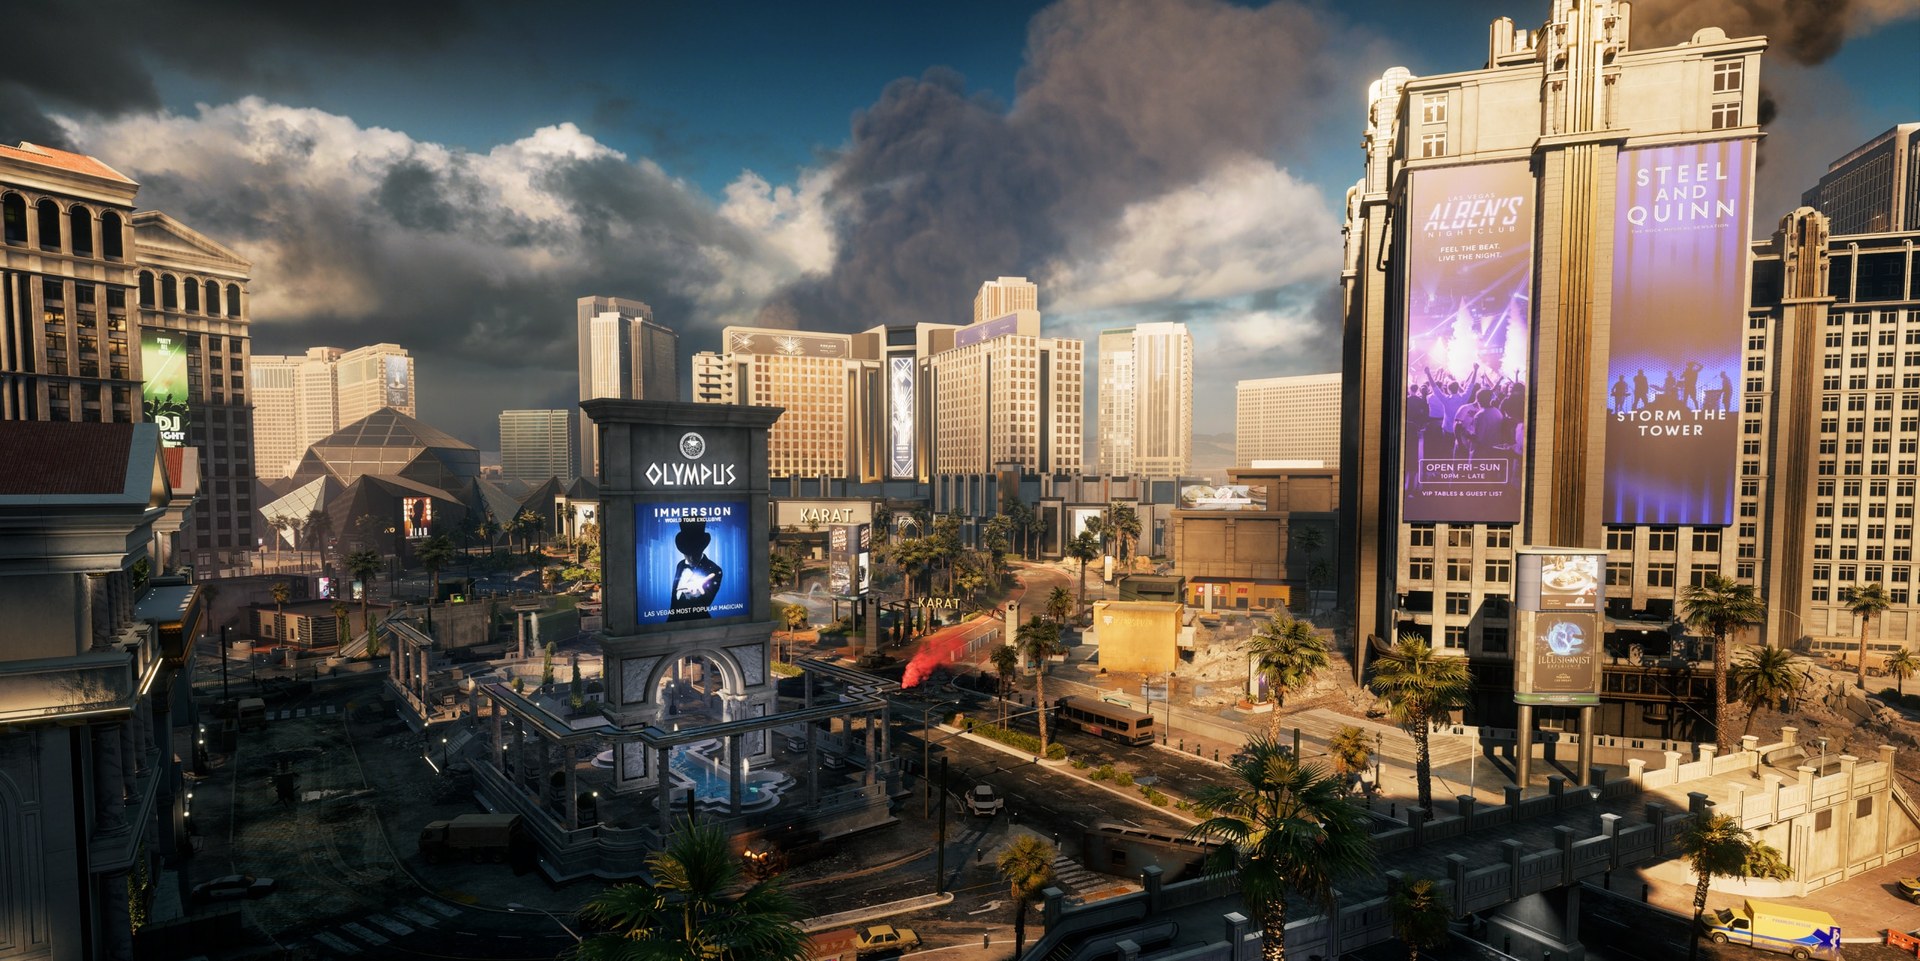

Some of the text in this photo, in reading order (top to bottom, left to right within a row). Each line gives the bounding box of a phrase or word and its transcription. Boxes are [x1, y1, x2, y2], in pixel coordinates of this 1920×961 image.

[1636, 161, 1728, 187] STEEL
[1655, 185, 1707, 202] AND
[1423, 196, 1524, 231] ALBEN'S
[1627, 199, 1735, 226] QUINN
[1427, 226, 1515, 238] NIGHTCLUB
[1479, 243, 1501, 251] BEAT.
[1458, 253, 1473, 261] THE
[1475, 252, 1503, 260] NIGHT.
[1617, 408, 1726, 422] STORM THE
[154, 414, 180, 431] DJ
[160, 431, 185, 440] IGHT
[1638, 424, 1703, 437] TOWER
[645, 462, 737, 486] OLYMPUS
[1426, 463, 1454, 472] OPEN
[654, 506, 731, 518] IMMERSION
[800, 508, 853, 522] KARAT
[918, 597, 961, 609] KARAT
[656, 609, 675, 617] VEGAS
[676, 607, 691, 615] MOST
[692, 605, 718, 613] POPULAR
[718, 603, 744, 611] MAGICIAN
[1538, 655, 1592, 665] ILLUSIONIST
